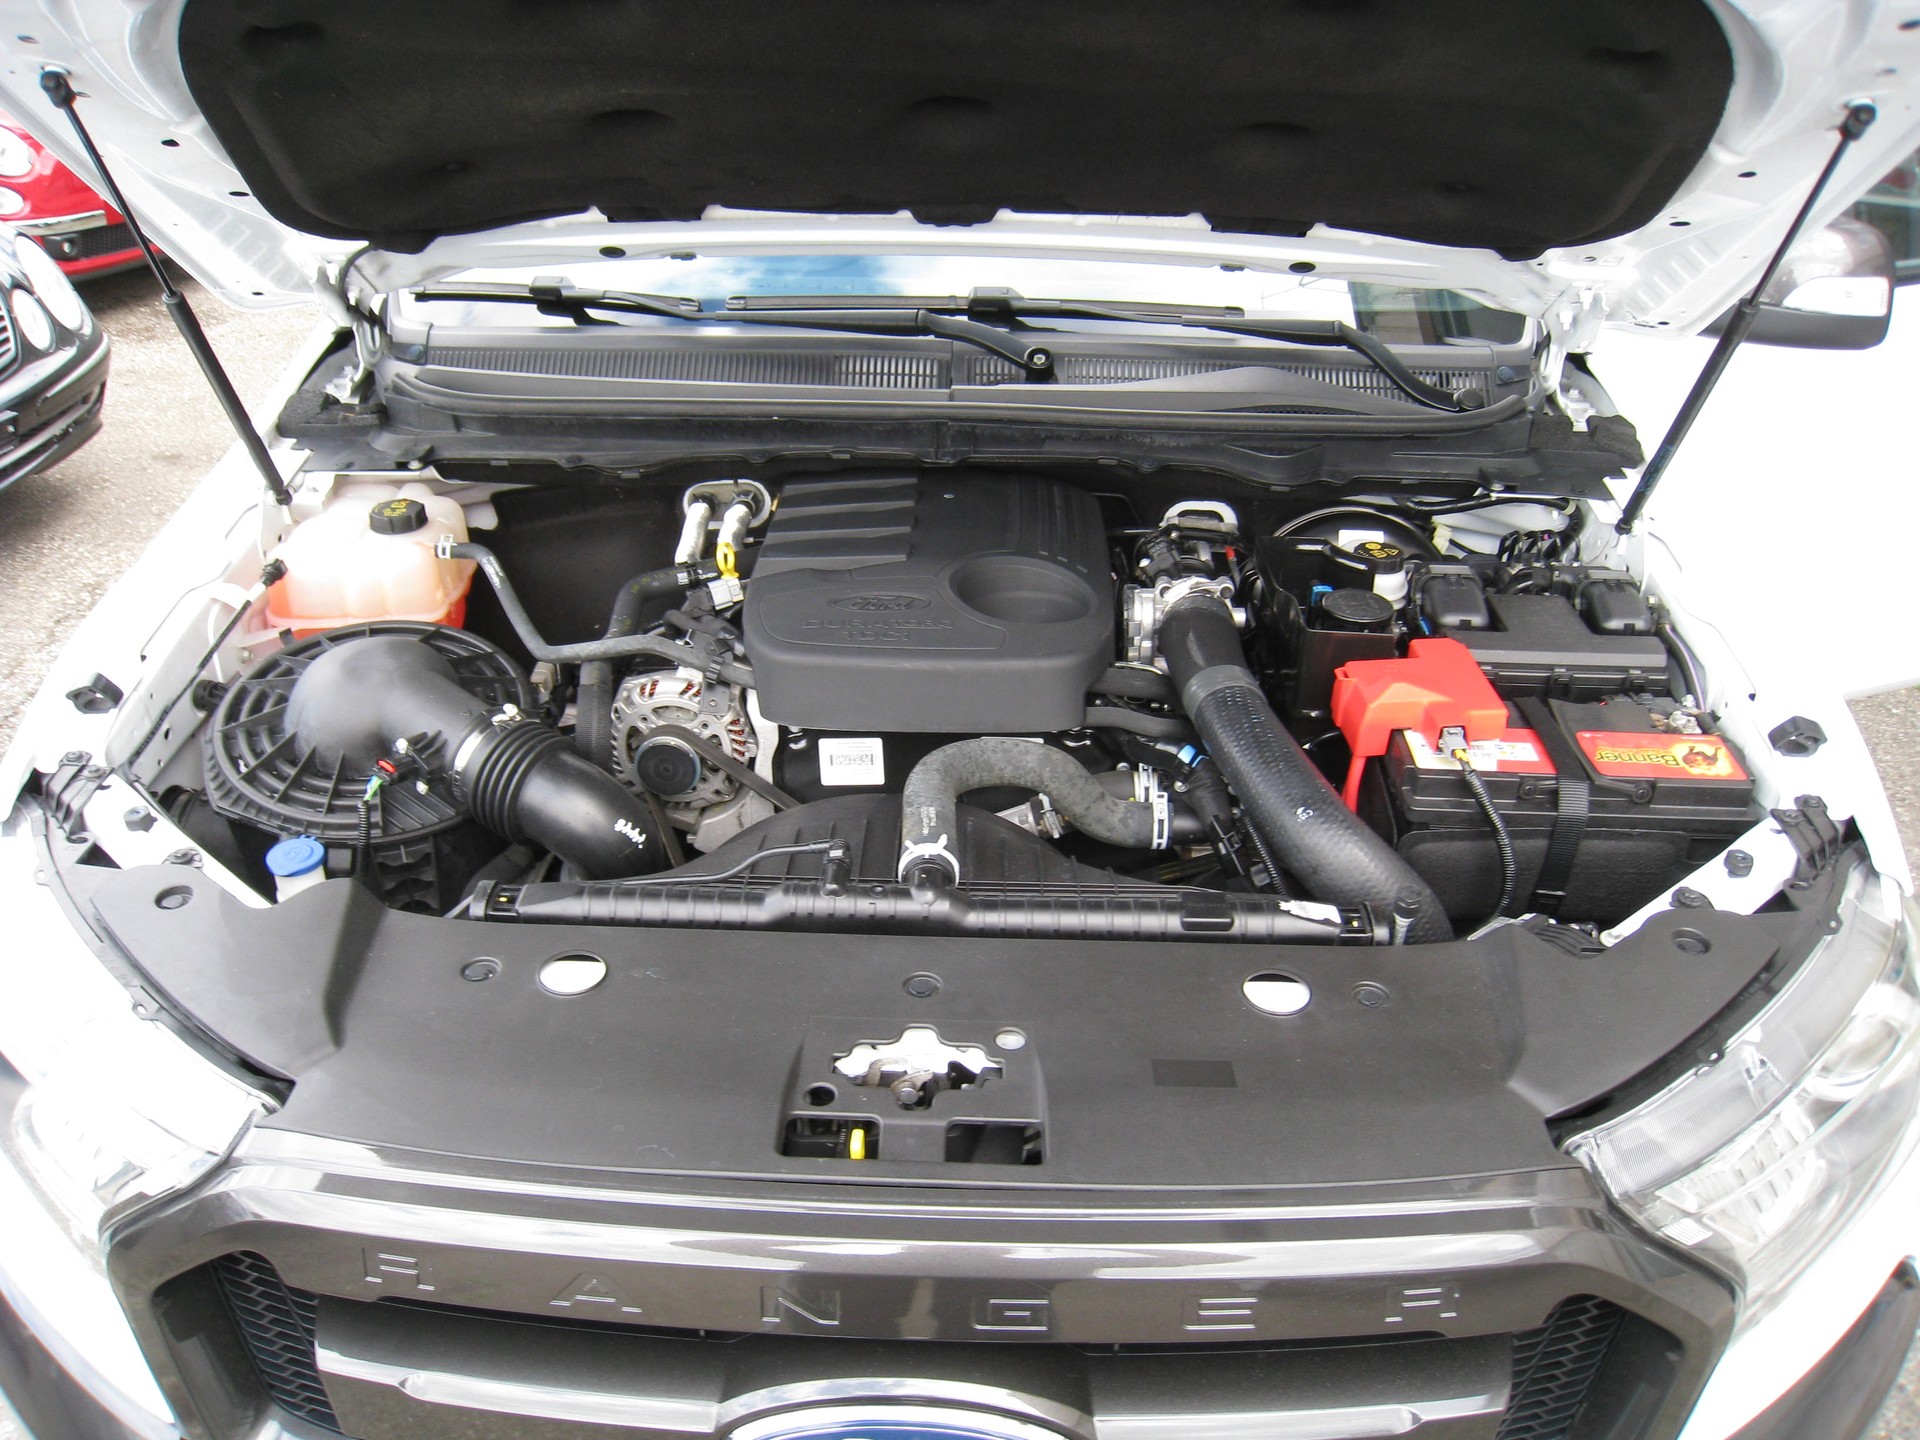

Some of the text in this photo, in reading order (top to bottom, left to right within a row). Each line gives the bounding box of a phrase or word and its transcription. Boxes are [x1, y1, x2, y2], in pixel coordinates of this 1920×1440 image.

[849, 595, 914, 610] Ford
[1595, 750, 1680, 767] Banner
[362, 1246, 1461, 1331] RANGER
